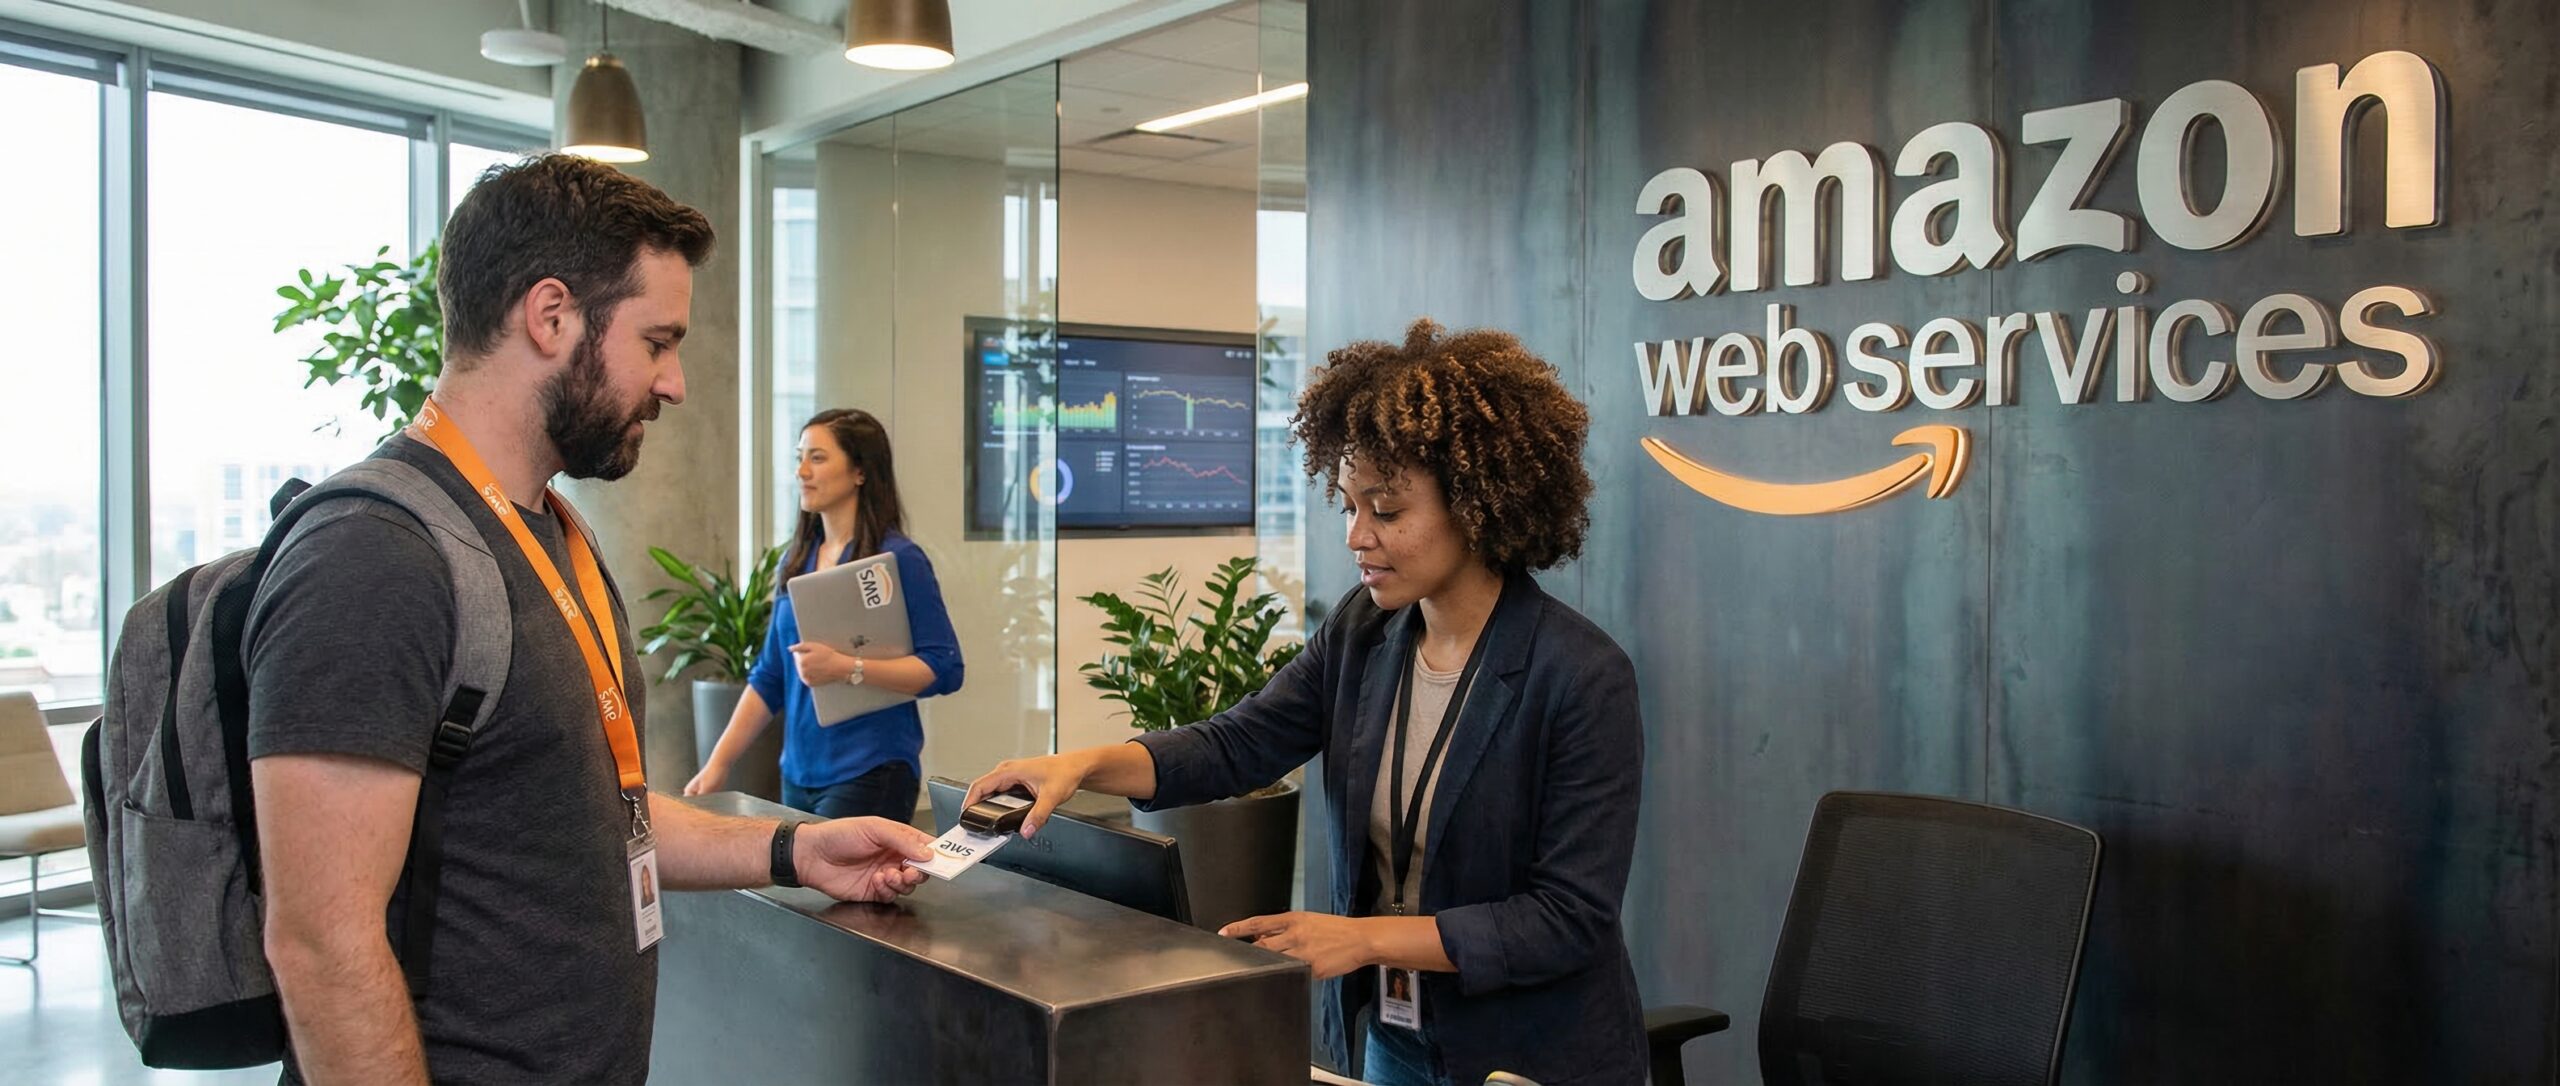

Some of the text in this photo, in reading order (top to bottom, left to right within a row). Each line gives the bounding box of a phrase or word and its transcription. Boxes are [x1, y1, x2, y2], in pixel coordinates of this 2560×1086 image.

[1632, 49, 2441, 302] amazon
[1634, 271, 2440, 418] web services
[859, 569, 881, 607] aws
[599, 690, 617, 722] aws
[939, 839, 976, 857] aws
